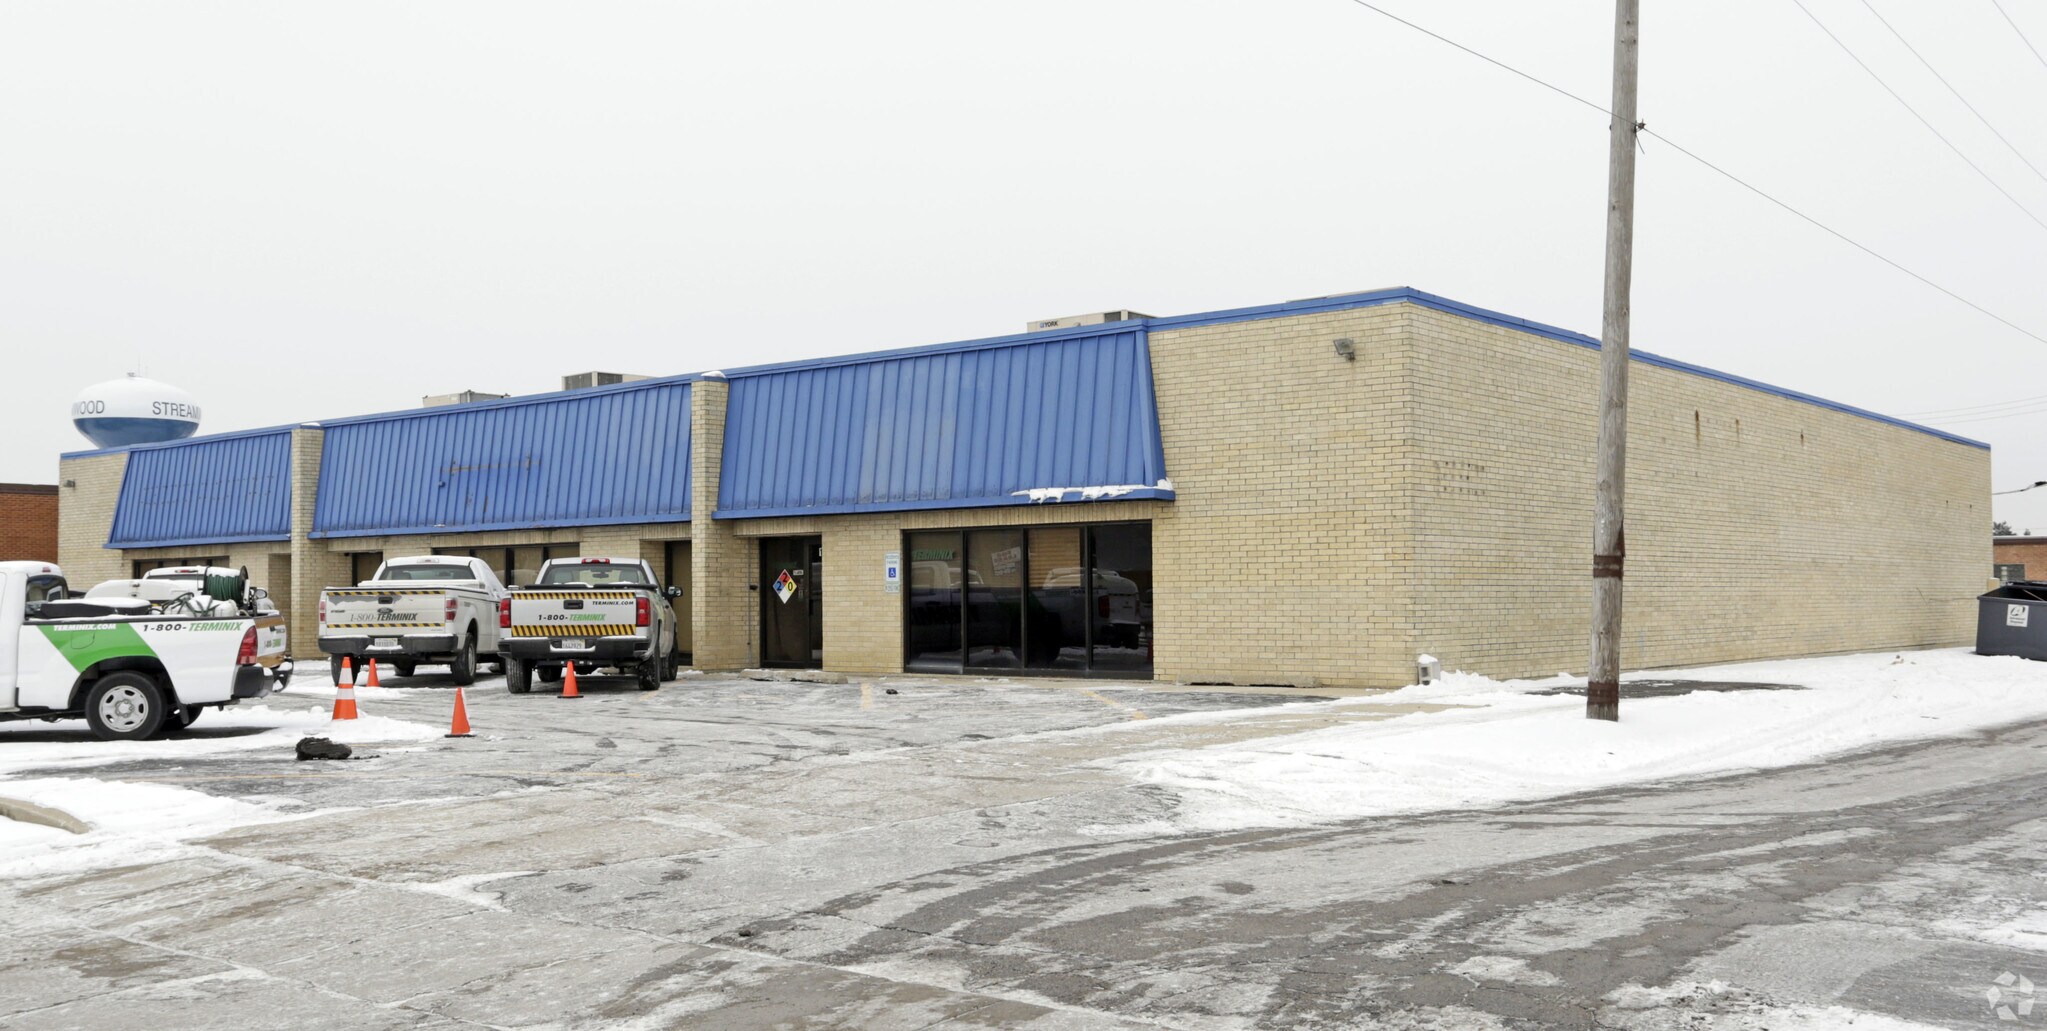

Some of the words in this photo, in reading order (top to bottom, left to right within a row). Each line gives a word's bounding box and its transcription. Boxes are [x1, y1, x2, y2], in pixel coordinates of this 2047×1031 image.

[72, 400, 105, 415] WOOD
[152, 401, 201, 419] STREAM
[782, 572, 788, 583] 2
[777, 581, 782, 592] 2
[787, 581, 793, 592] 0
[350, 612, 418, 623] 1-800-TERMINIX
[538, 613, 606, 622] 1-800-TERMINIX
[53, 623, 117, 632] TERMINIX.COM
[143, 621, 244, 632] 1-800-TERMINIX
